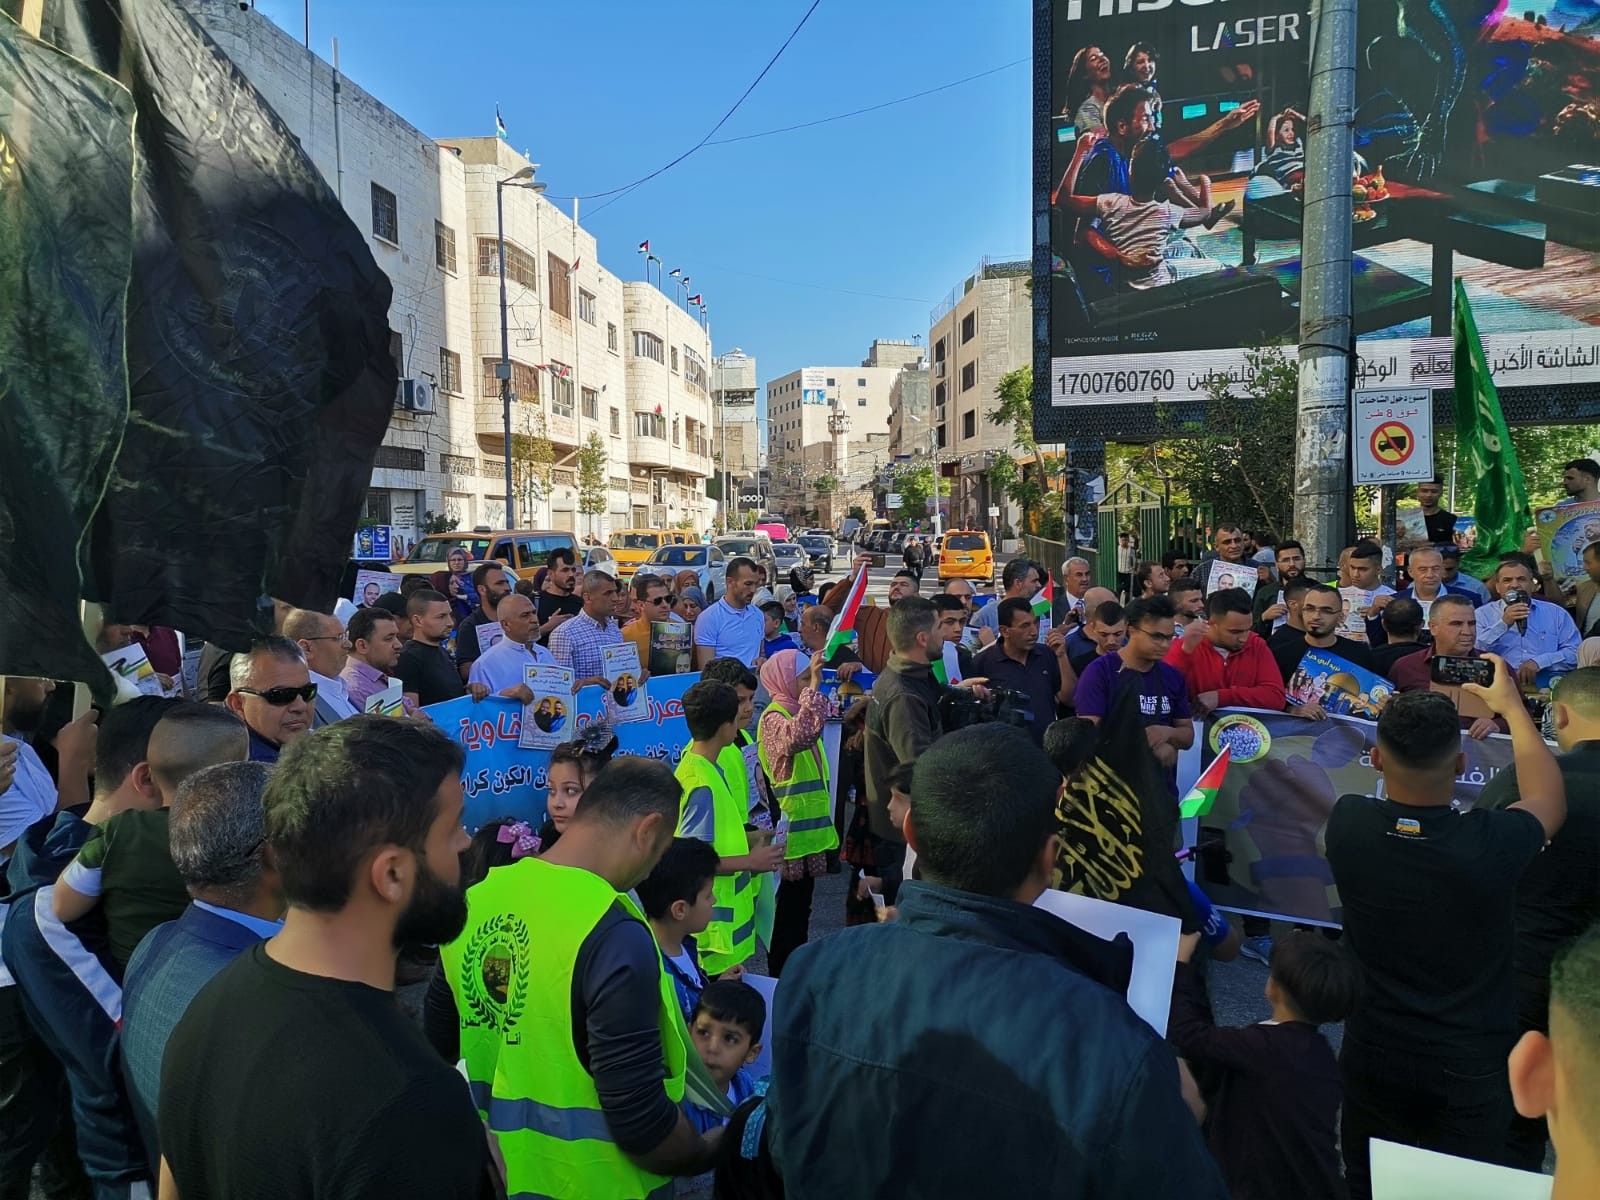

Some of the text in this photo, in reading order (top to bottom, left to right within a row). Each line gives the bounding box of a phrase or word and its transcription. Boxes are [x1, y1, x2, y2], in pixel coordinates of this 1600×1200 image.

[1191, 13, 1300, 52] LASER
[1058, 368, 1175, 395] 1700760760
[1387, 408, 1393, 418] 8
